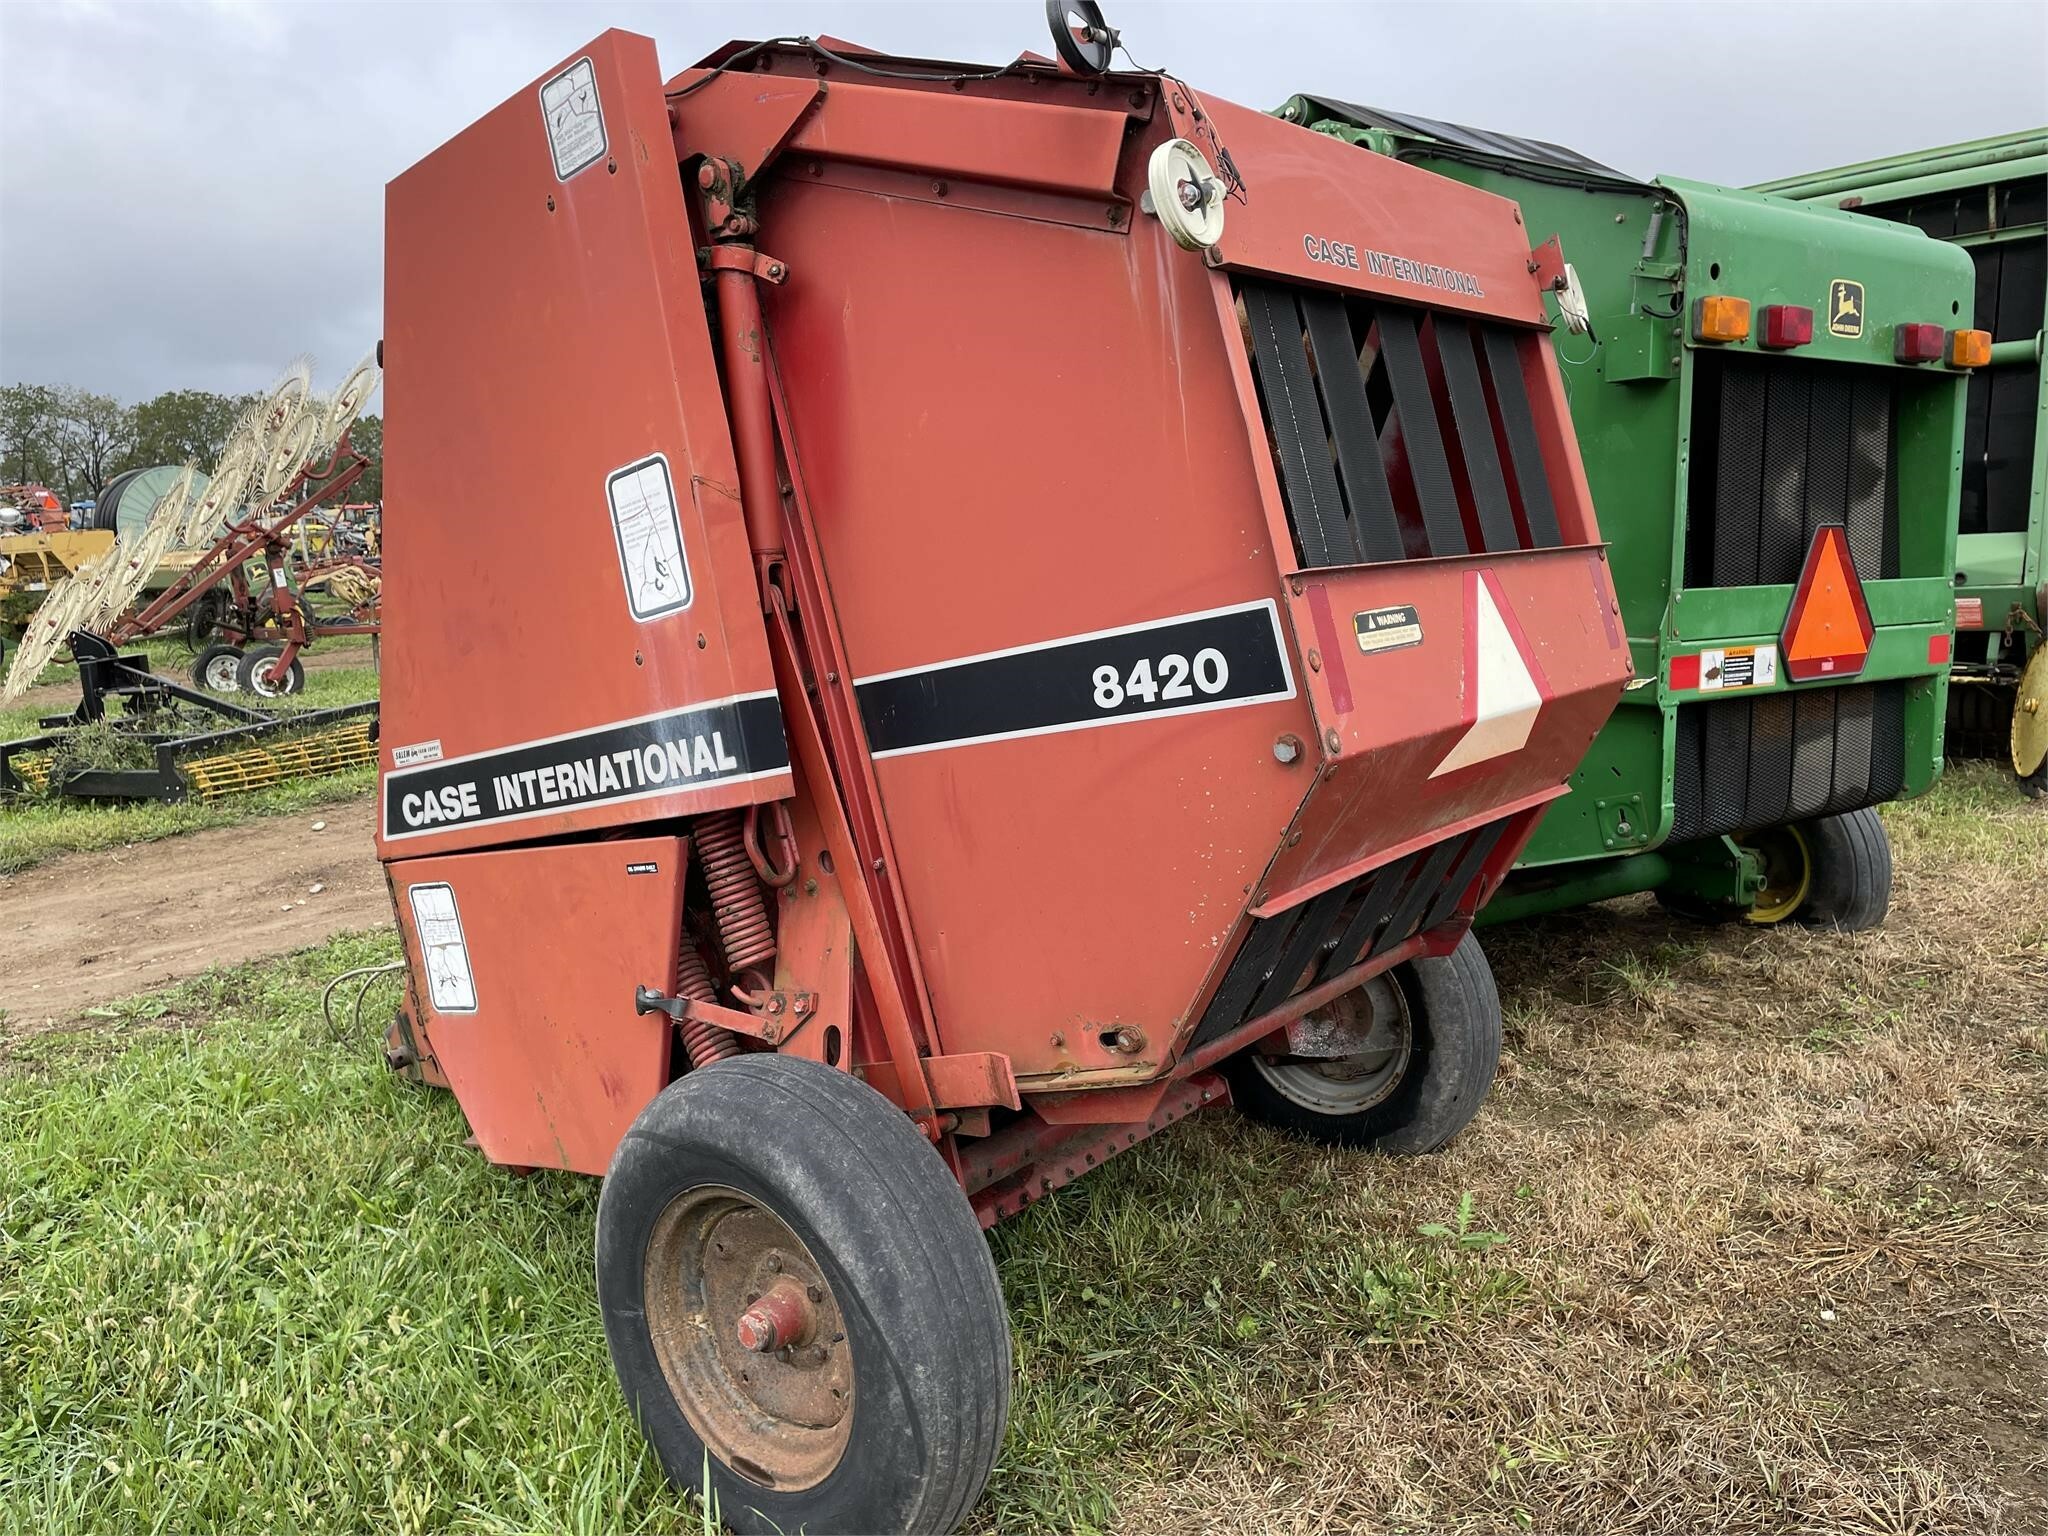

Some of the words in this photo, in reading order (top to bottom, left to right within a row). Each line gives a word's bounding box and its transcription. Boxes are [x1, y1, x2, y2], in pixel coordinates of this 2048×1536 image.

[1304, 233, 1360, 270] CASE
[1365, 249, 1485, 298] INTERNATIONAL
[1376, 612, 1406, 626] WARNING
[1092, 647, 1229, 709] 8420
[402, 782, 481, 827] CASE
[493, 731, 738, 811] INTERNATIONAL
